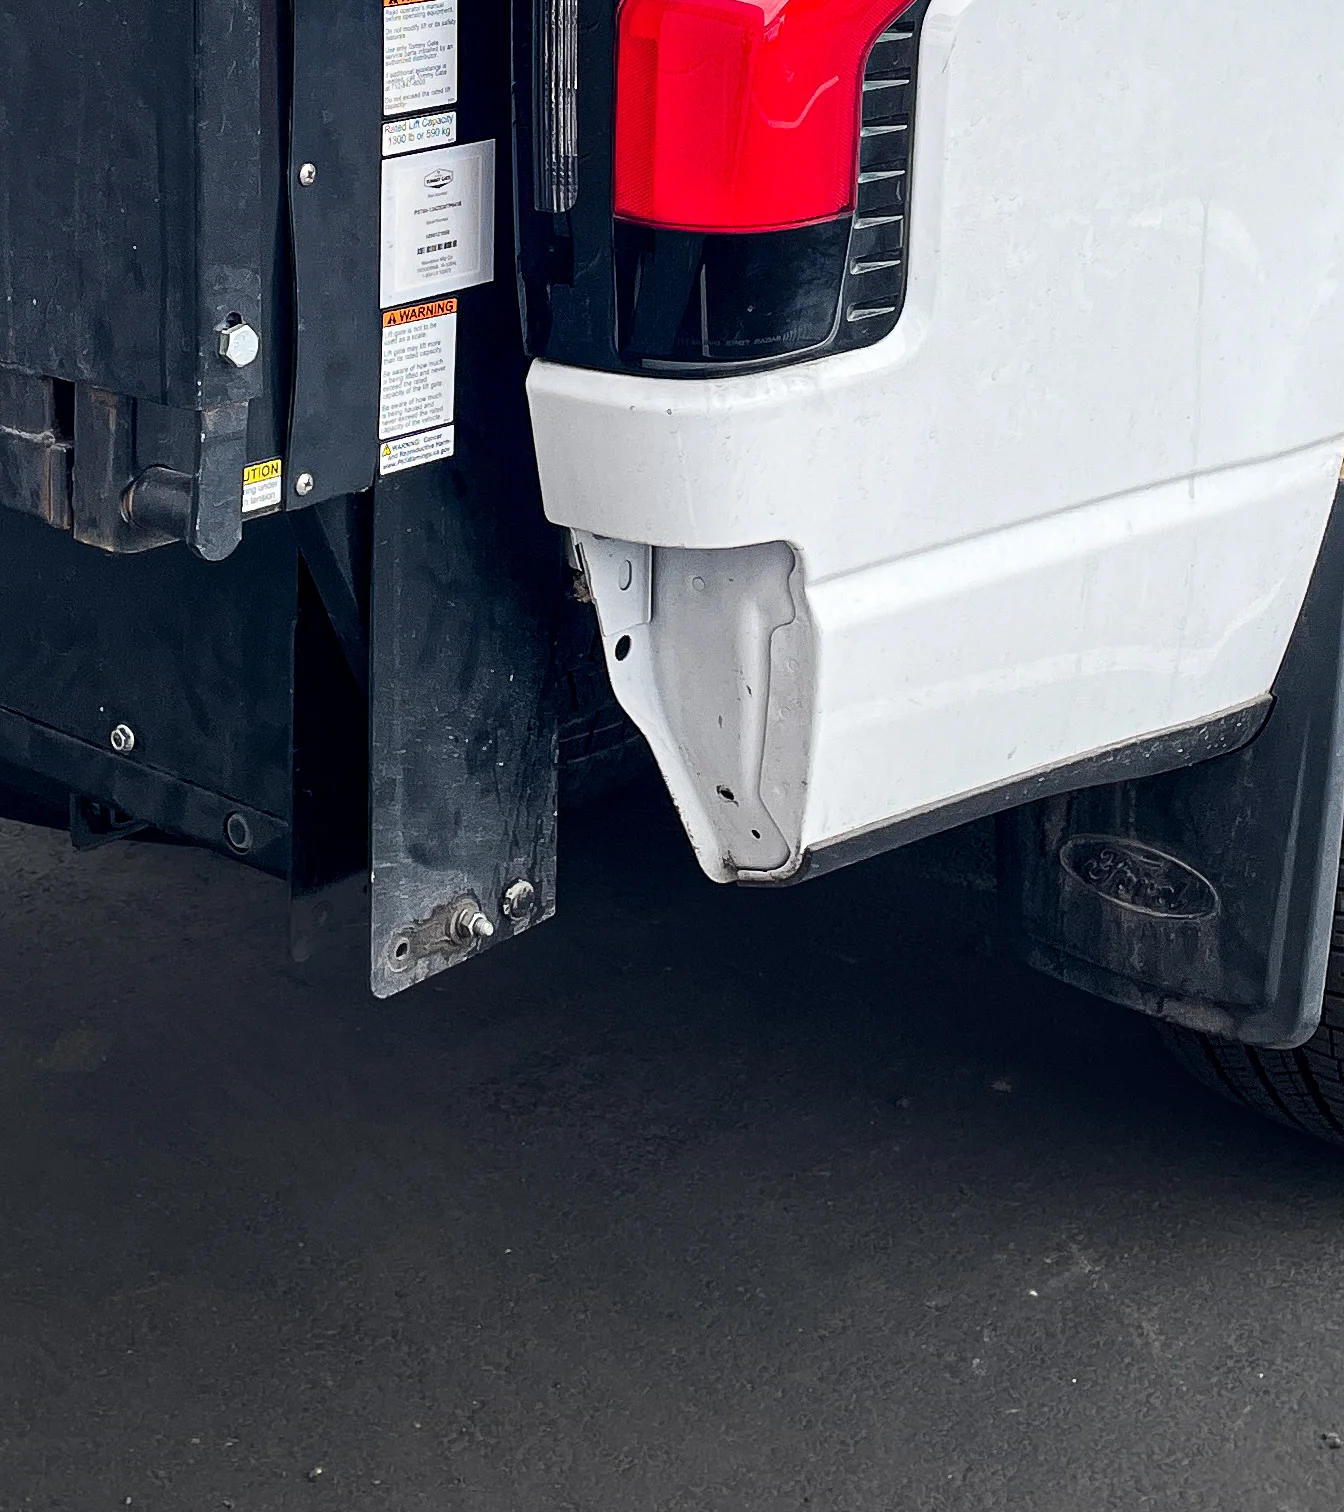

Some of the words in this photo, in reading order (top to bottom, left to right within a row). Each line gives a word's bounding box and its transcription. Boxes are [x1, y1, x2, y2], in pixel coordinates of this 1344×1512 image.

[385, 122, 406, 134] Rated
[409, 120, 420, 130] Lift
[422, 114, 453, 129] Capacity
[426, 128, 440, 138] 590
[442, 126, 450, 137] kg
[399, 300, 454, 322] WARNING
